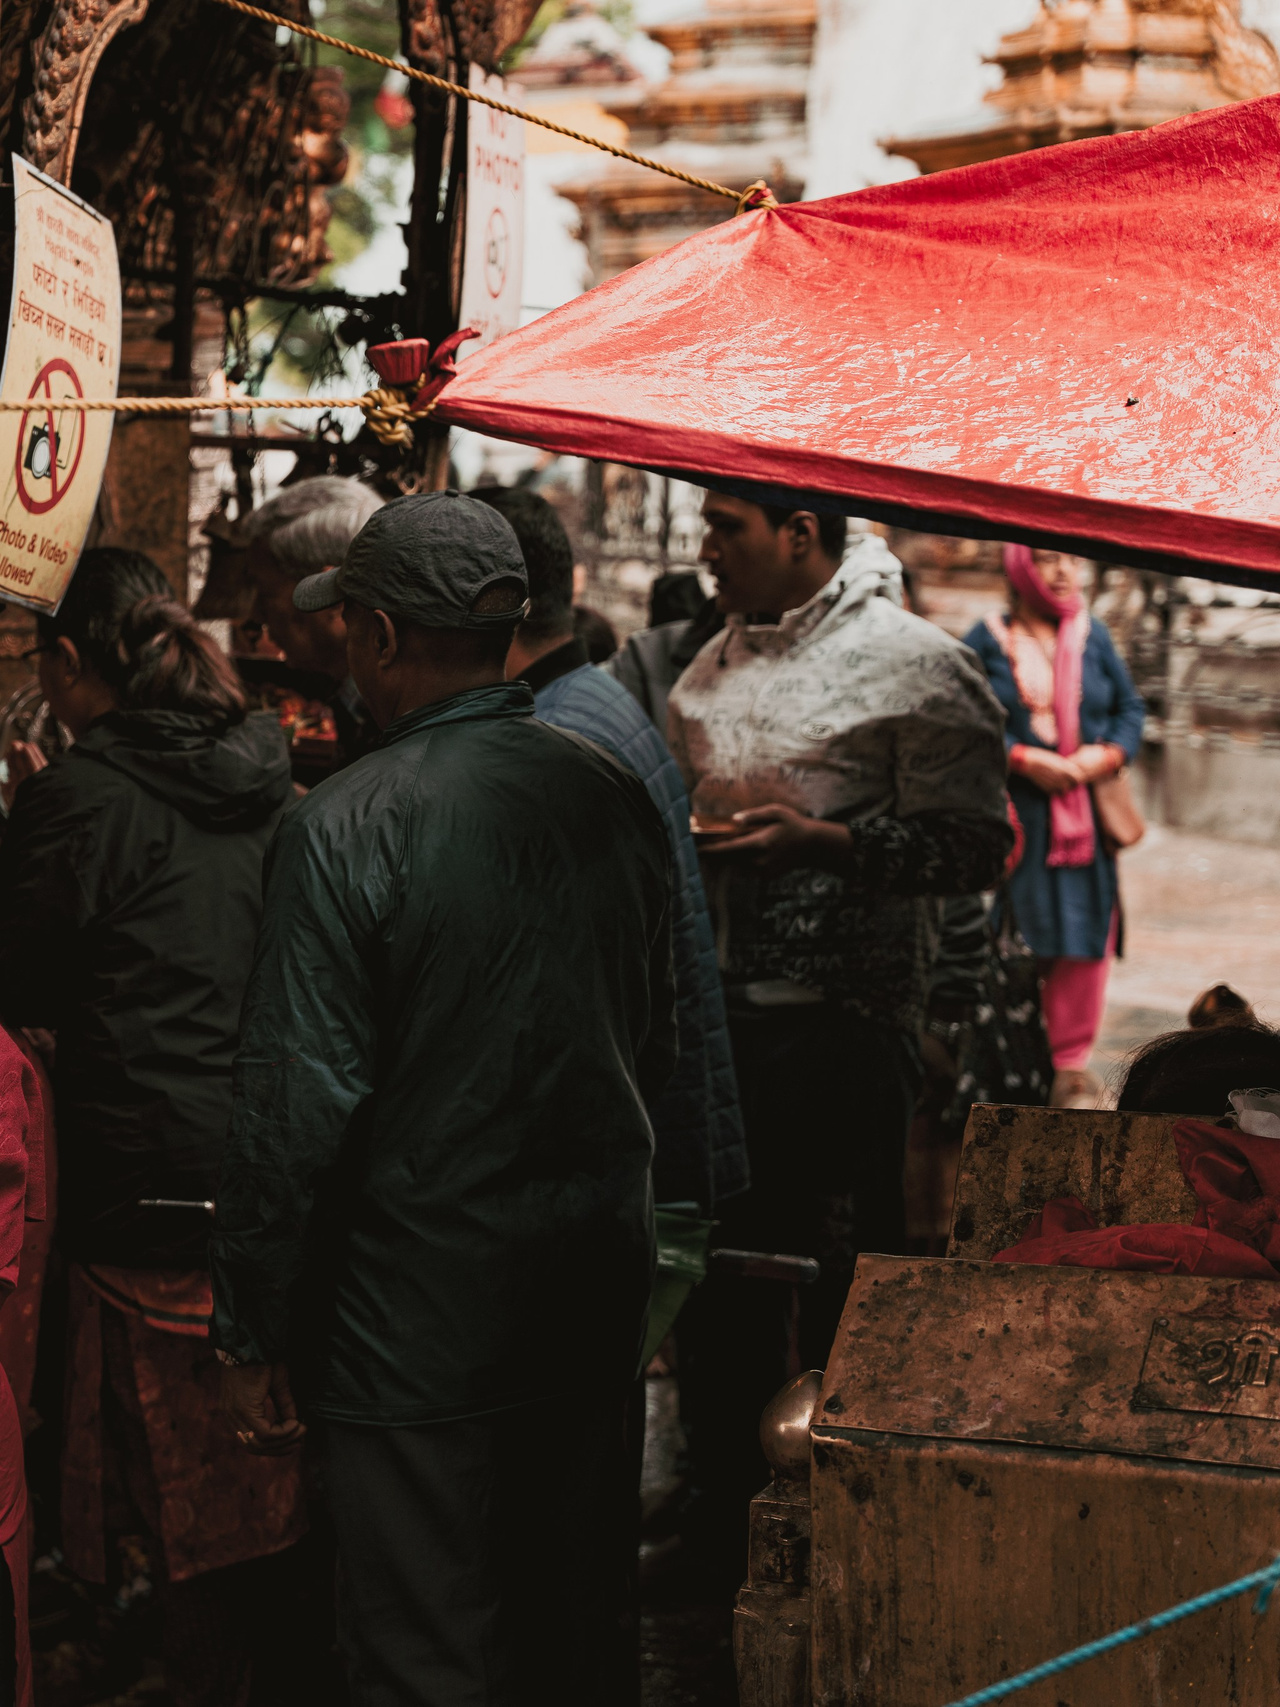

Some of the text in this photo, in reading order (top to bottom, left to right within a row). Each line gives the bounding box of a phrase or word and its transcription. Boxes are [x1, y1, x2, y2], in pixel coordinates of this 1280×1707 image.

[475, 144, 521, 191] PHOTO
[32, 261, 58, 296] फोटो
[61, 280, 69, 308] र
[27, 533, 38, 554] &
[39, 537, 68, 565] Video
